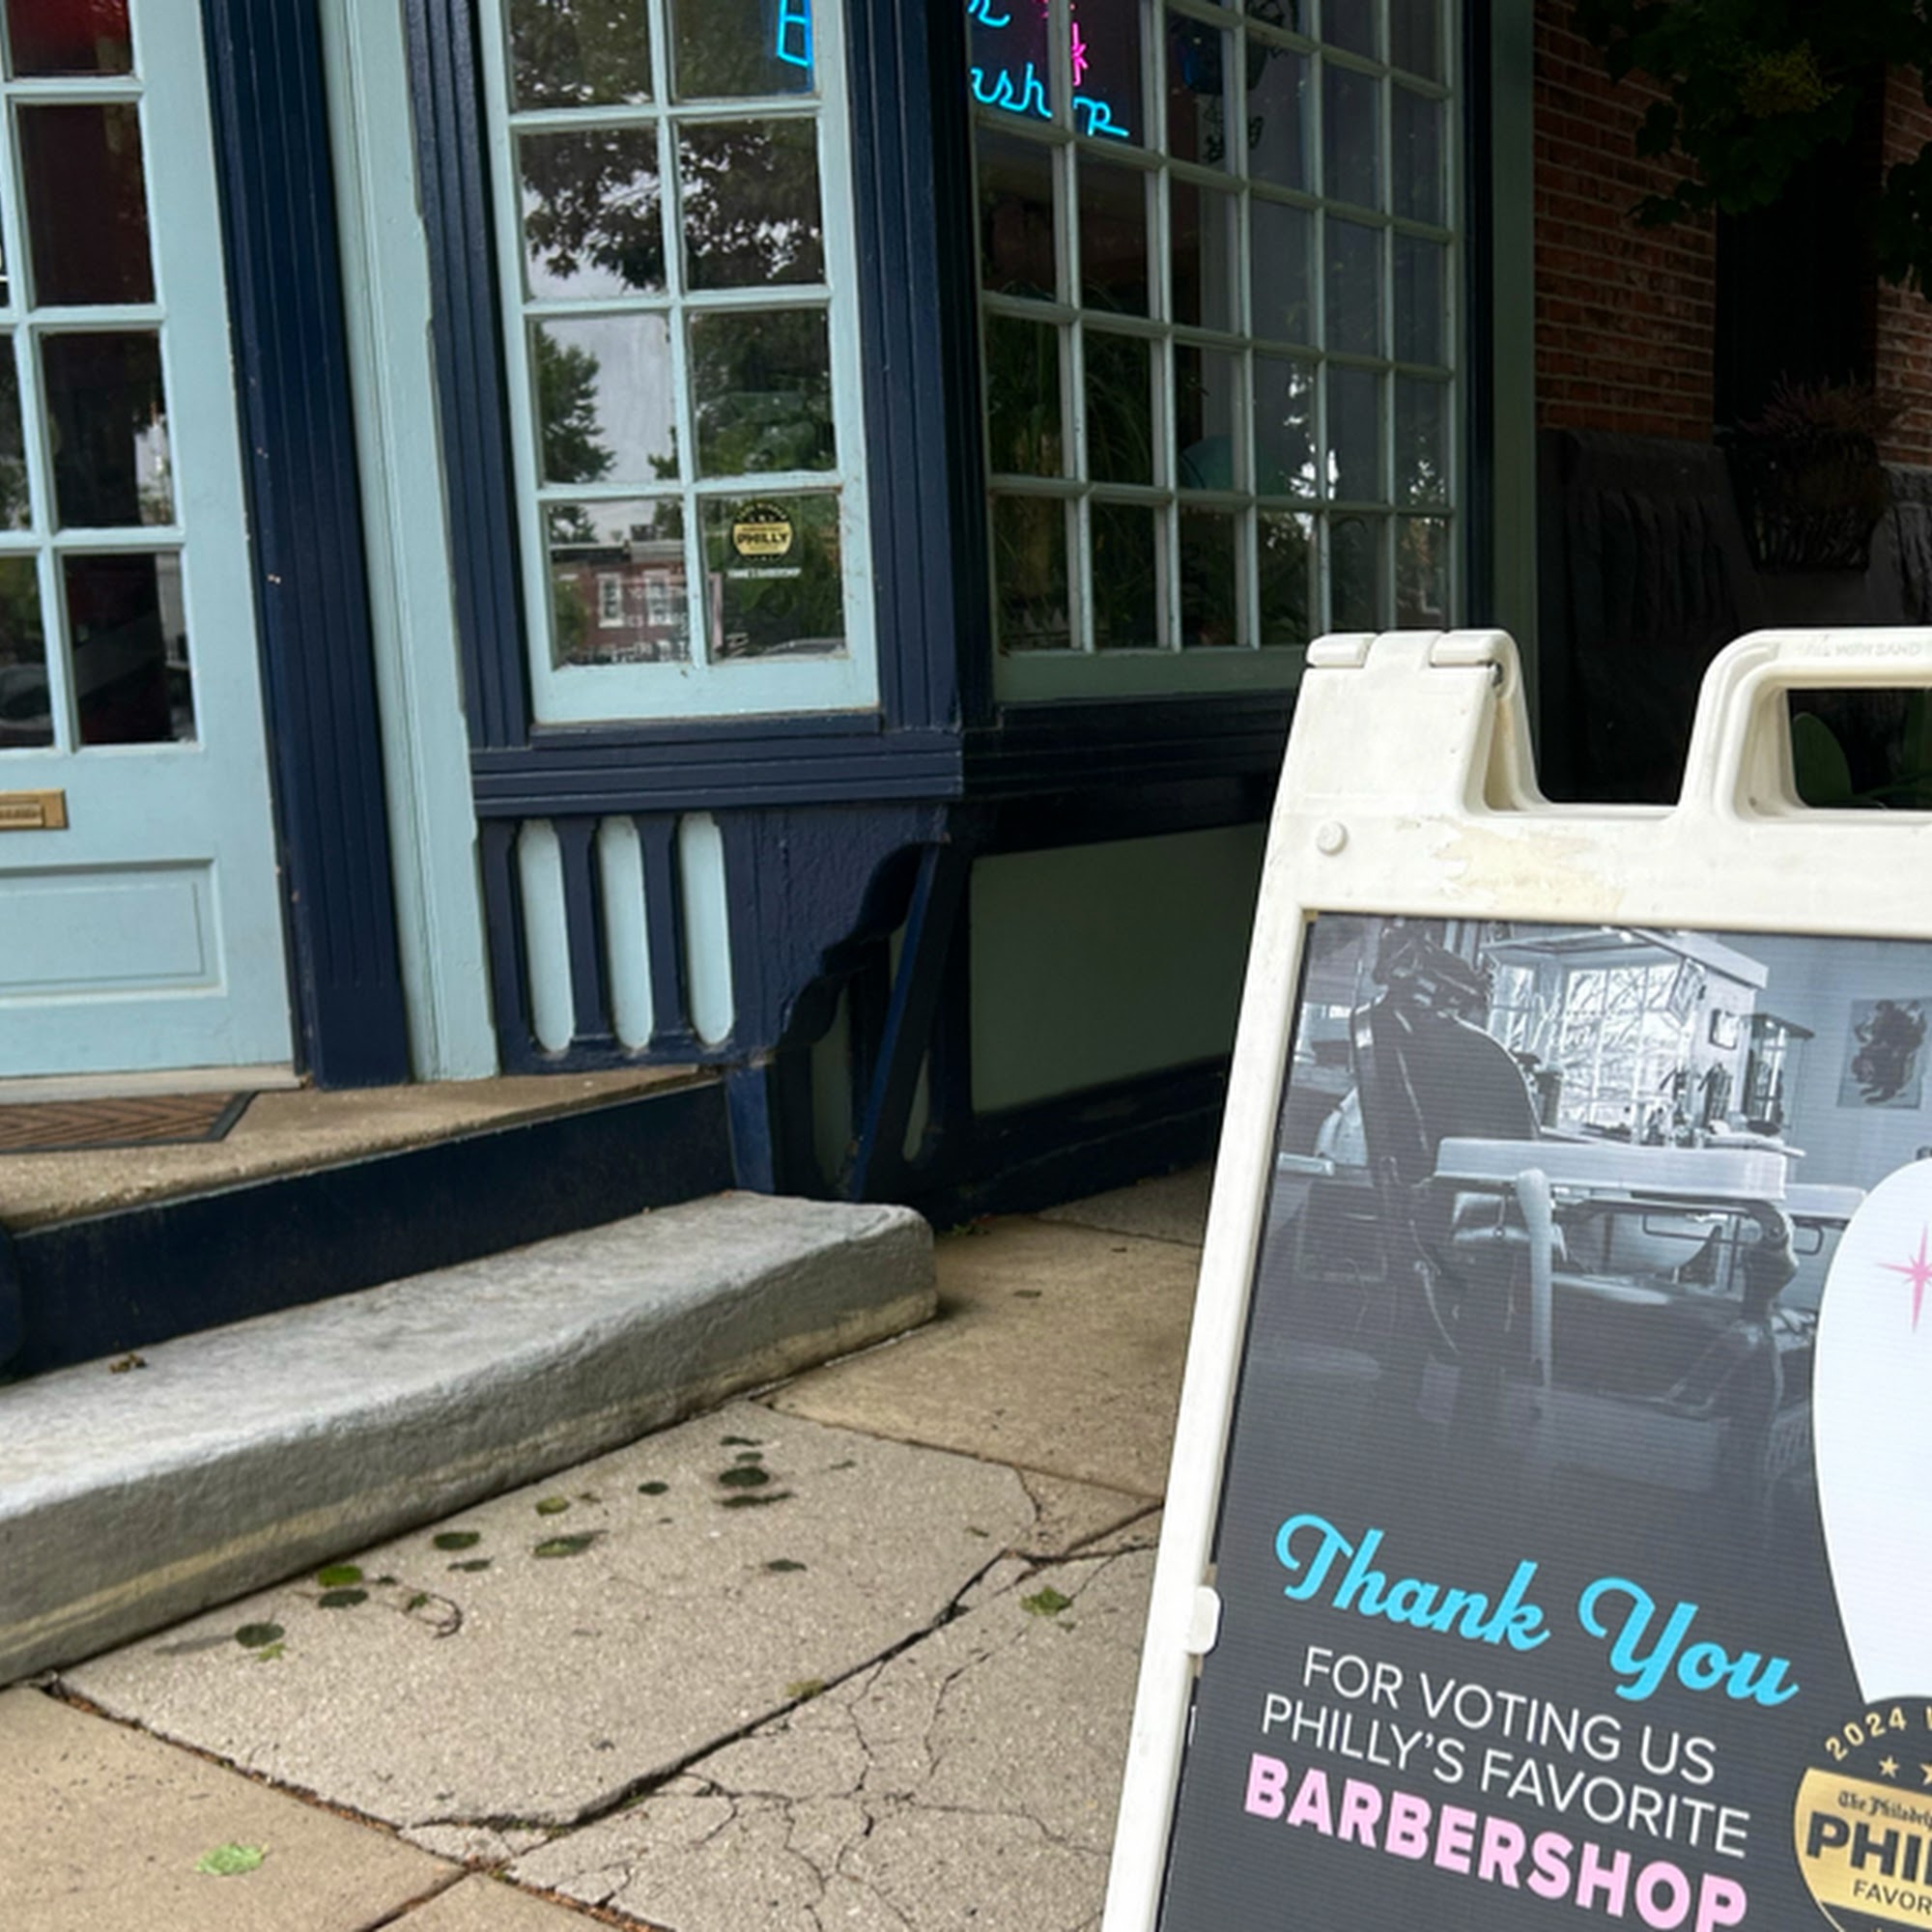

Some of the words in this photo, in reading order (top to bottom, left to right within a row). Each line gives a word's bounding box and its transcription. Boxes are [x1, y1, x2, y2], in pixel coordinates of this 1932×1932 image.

[736, 532, 788, 545] PHILLY
[1274, 1514, 1550, 1651] Thank
[1578, 1577, 1800, 1706] You
[1262, 1693, 1466, 1783] PHILLY'S
[1480, 1748, 1750, 1859] FAVORITE
[1302, 1646, 1404, 1710] FOR
[1419, 1672, 1624, 1762] VOTING
[1642, 1725, 1717, 1785] US
[1825, 1706, 1907, 1761] 2024
[1244, 1752, 1747, 1932] BARBERSHOP
[1837, 1790, 1866, 1811] The
